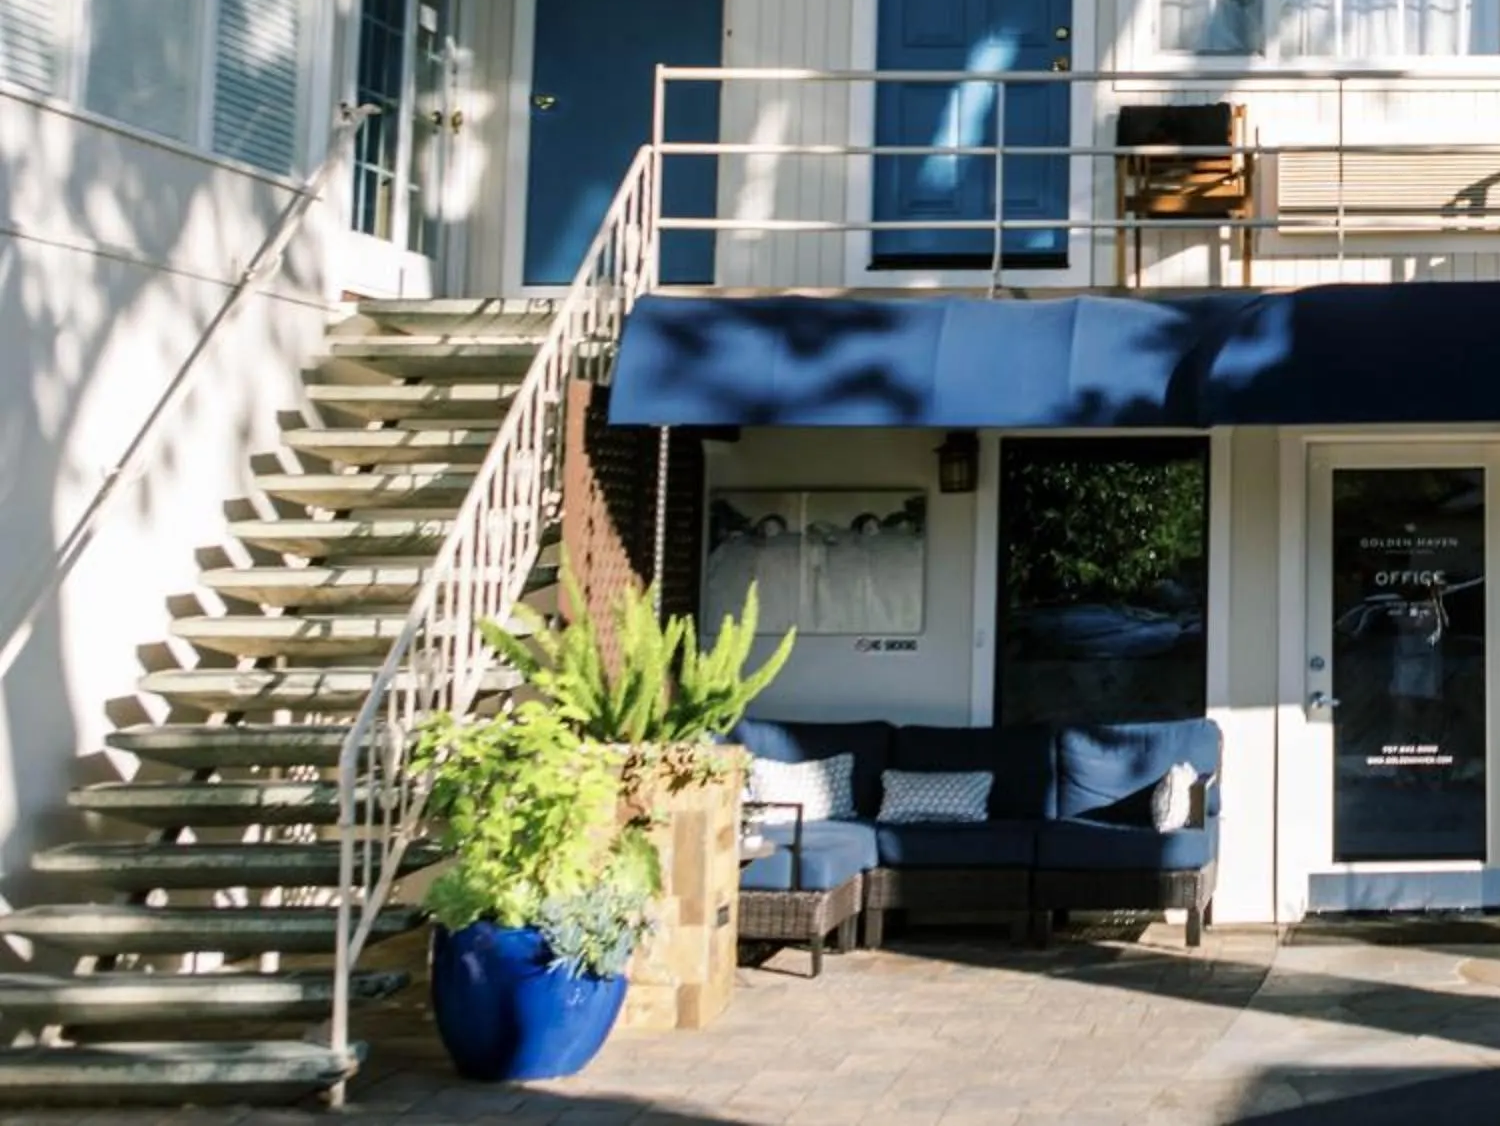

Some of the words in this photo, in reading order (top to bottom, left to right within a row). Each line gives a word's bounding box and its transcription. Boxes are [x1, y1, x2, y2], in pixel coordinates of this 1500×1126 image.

[1360, 537, 1412, 548] GOLDEN
[1417, 537, 1459, 548] HAVEN
[1375, 569, 1446, 586] OFFICE
